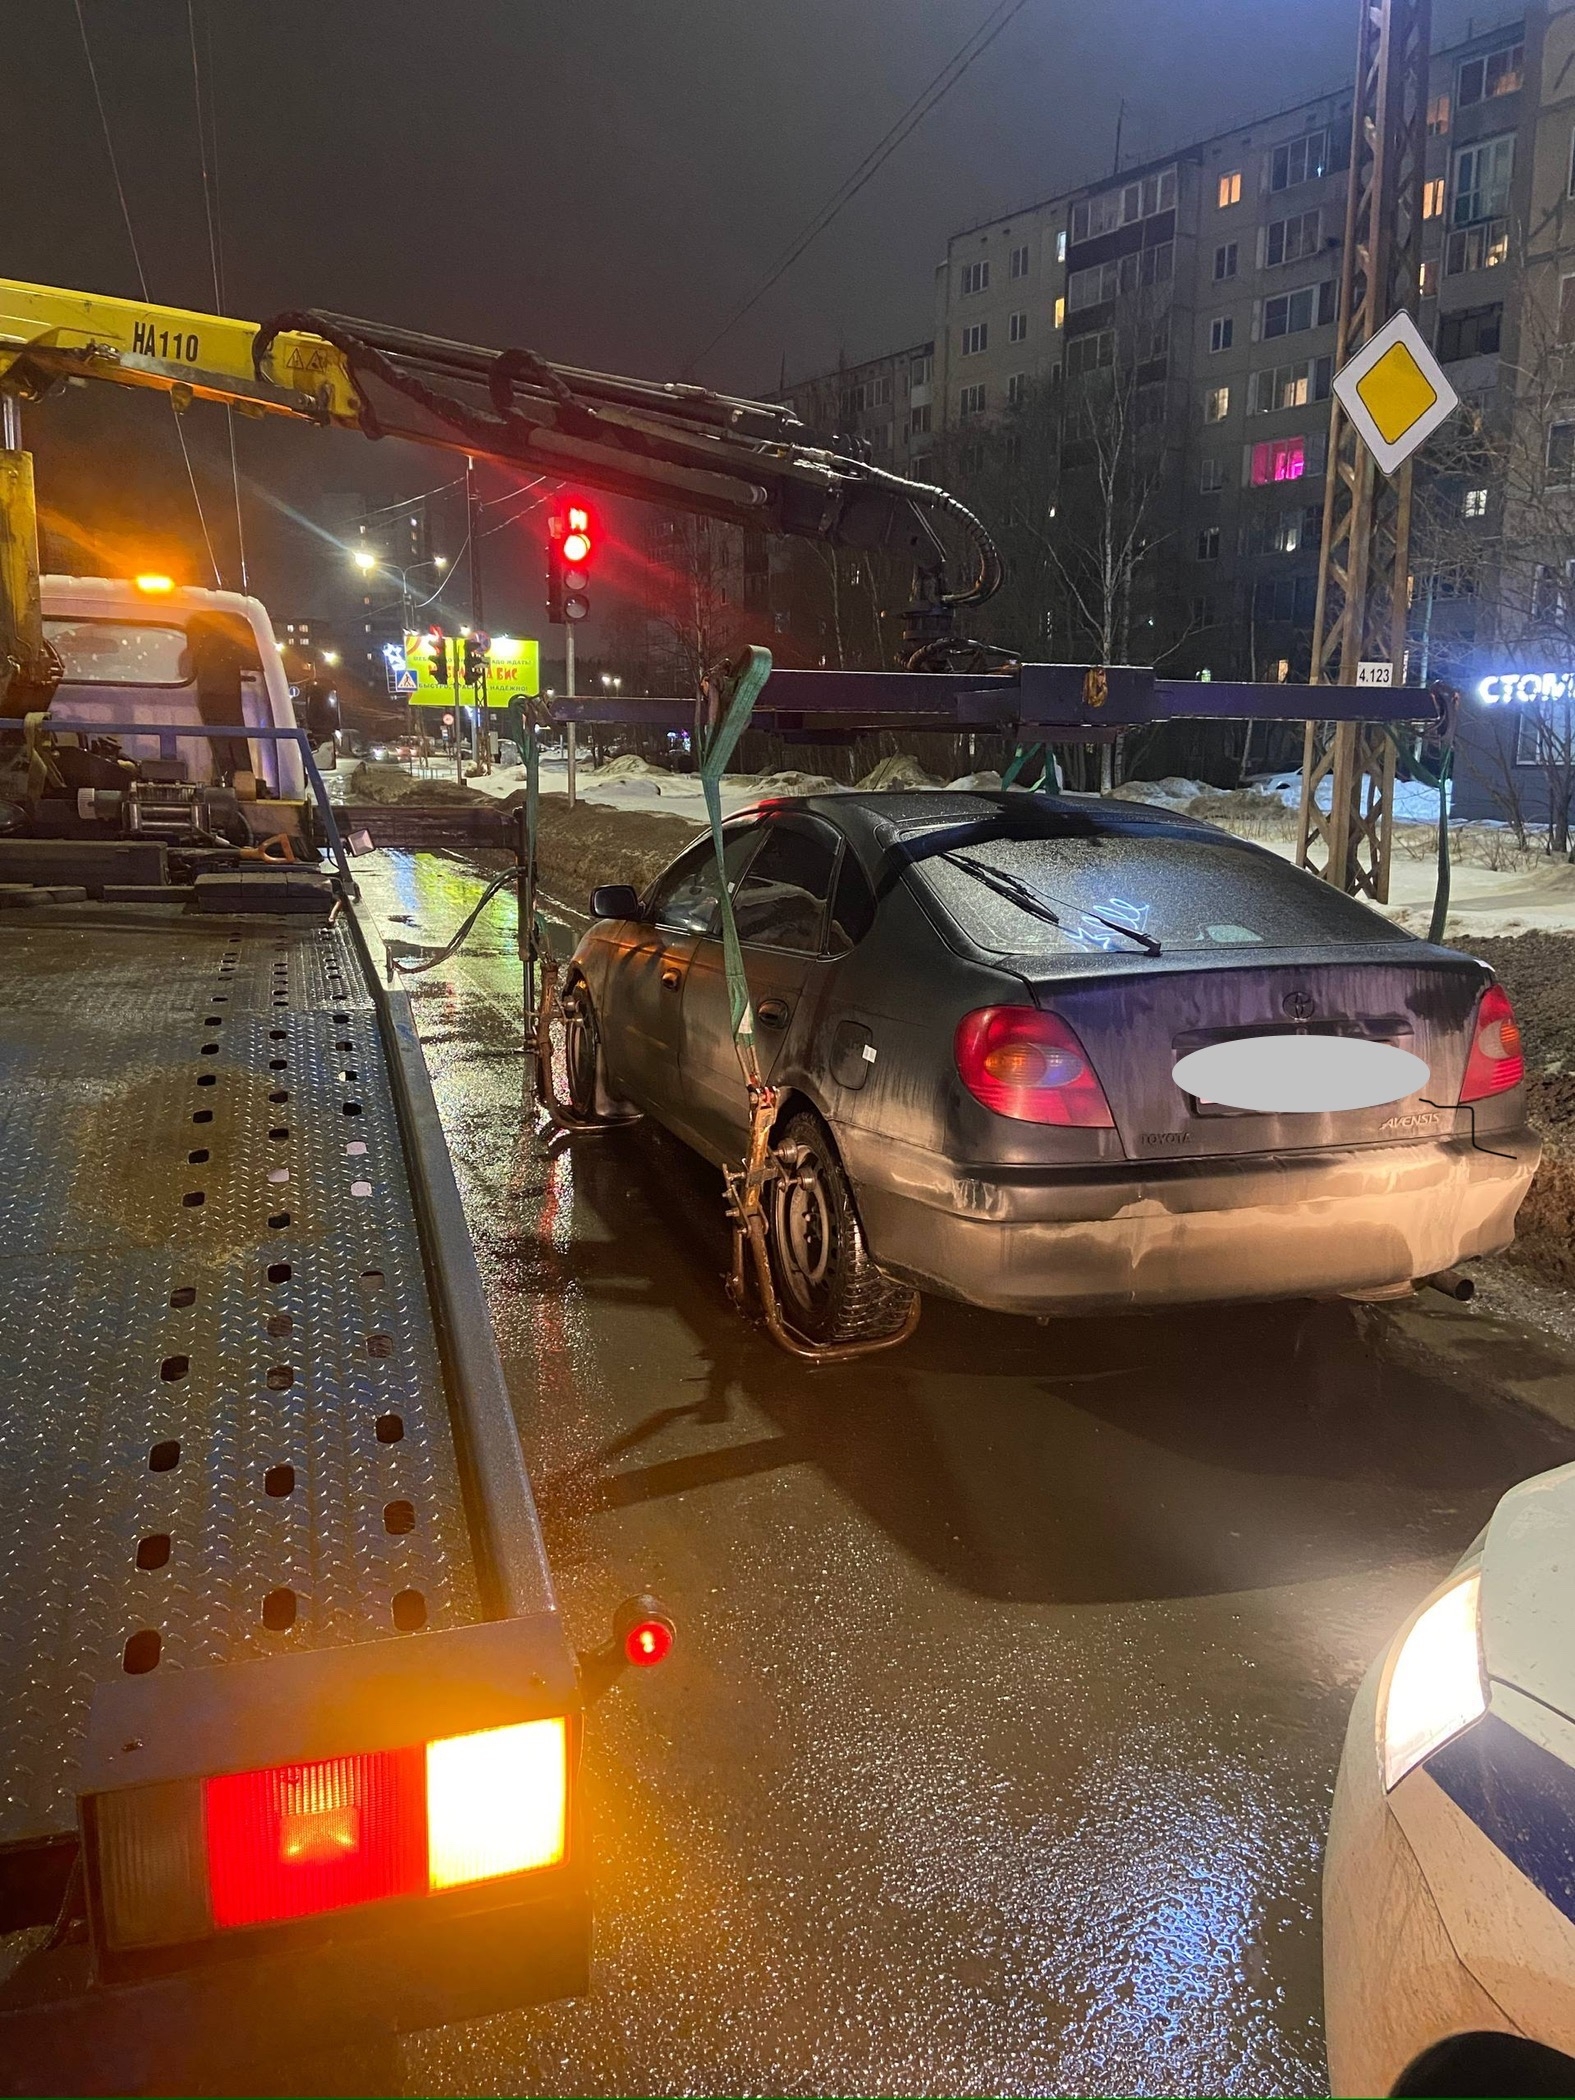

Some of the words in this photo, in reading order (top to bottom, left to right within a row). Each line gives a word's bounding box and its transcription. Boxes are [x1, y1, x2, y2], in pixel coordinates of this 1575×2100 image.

[132, 321, 199, 362] HA110
[496, 667, 518, 681] БИС
[1359, 668, 1390, 683] 4.123
[1379, 1112, 1440, 1131] AVENSIS
[1140, 1131, 1191, 1145] TOYOTA
